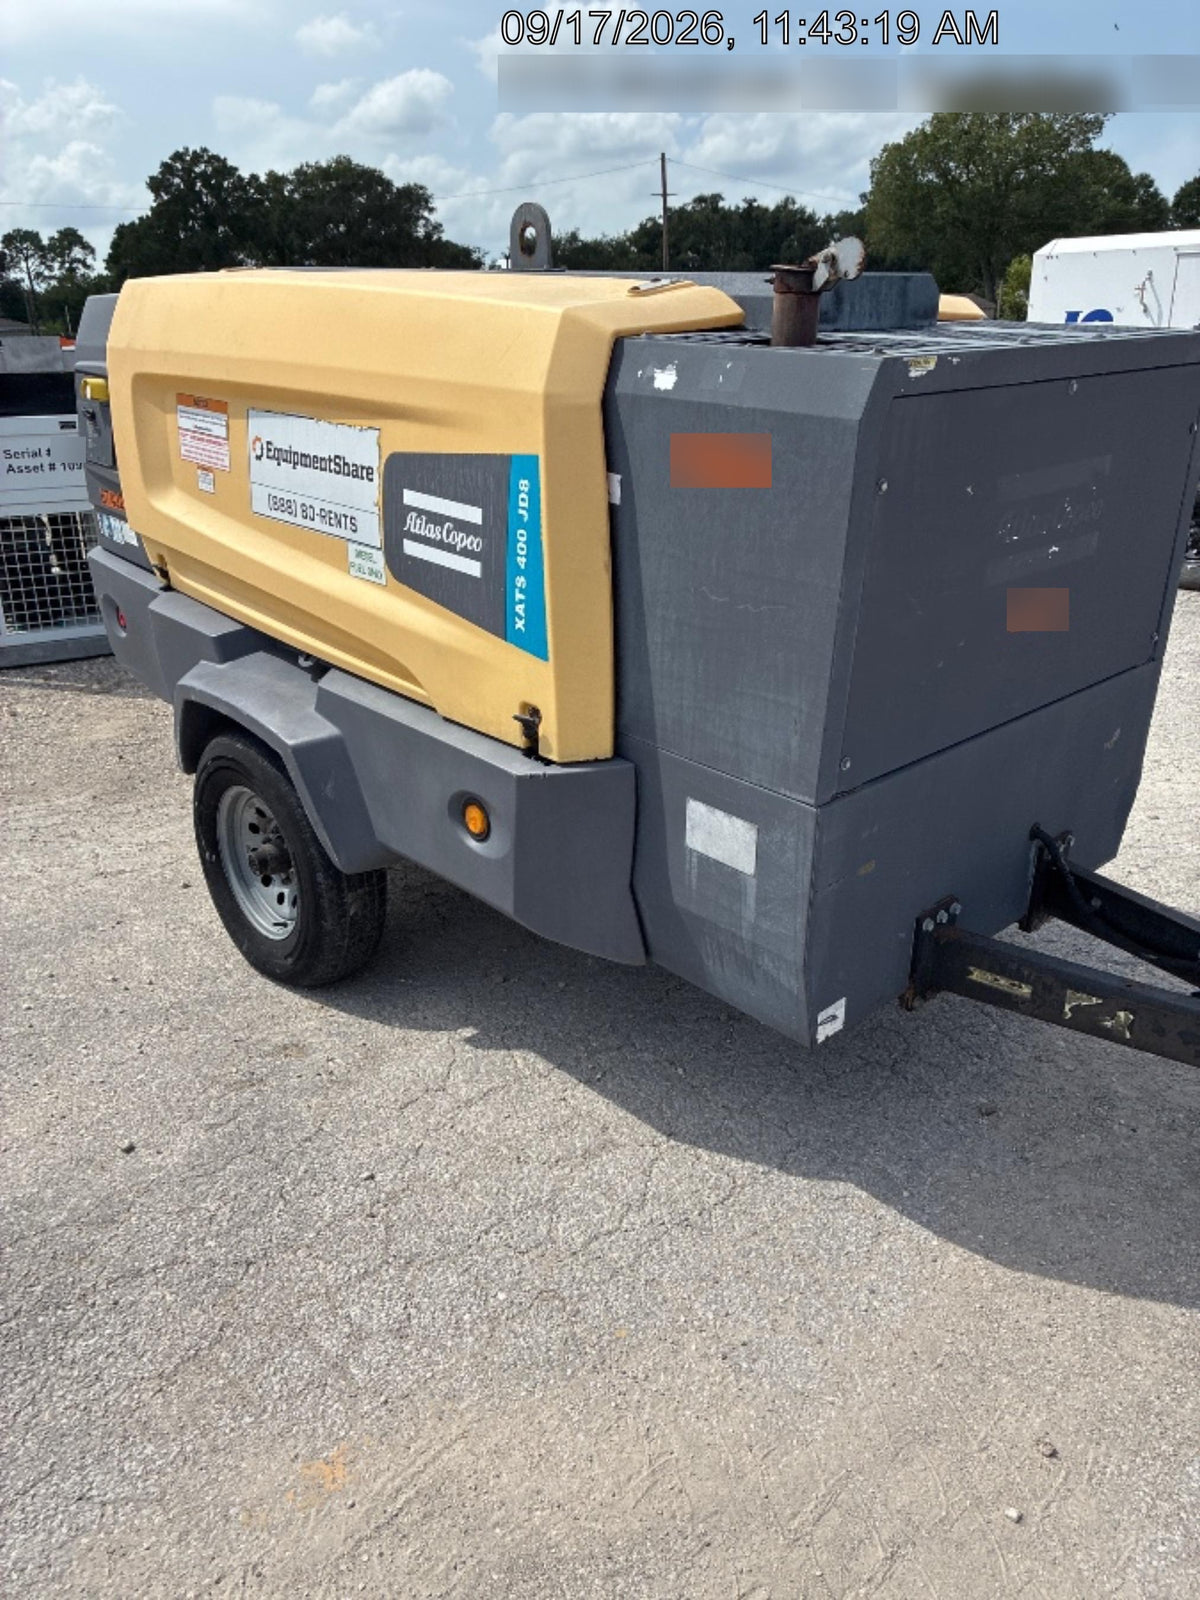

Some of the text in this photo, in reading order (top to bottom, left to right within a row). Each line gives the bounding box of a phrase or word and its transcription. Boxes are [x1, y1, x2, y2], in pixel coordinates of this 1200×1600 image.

[3, 447, 42, 460] Serial
[6, 463, 45, 475] Asset
[48, 462, 56, 472] #
[265, 440, 375, 482] EquipmentShare
[267, 493, 297, 518] (888)
[403, 511, 483, 552] Atlas Copco
[514, 478, 530, 633] XATS 400 JD8
